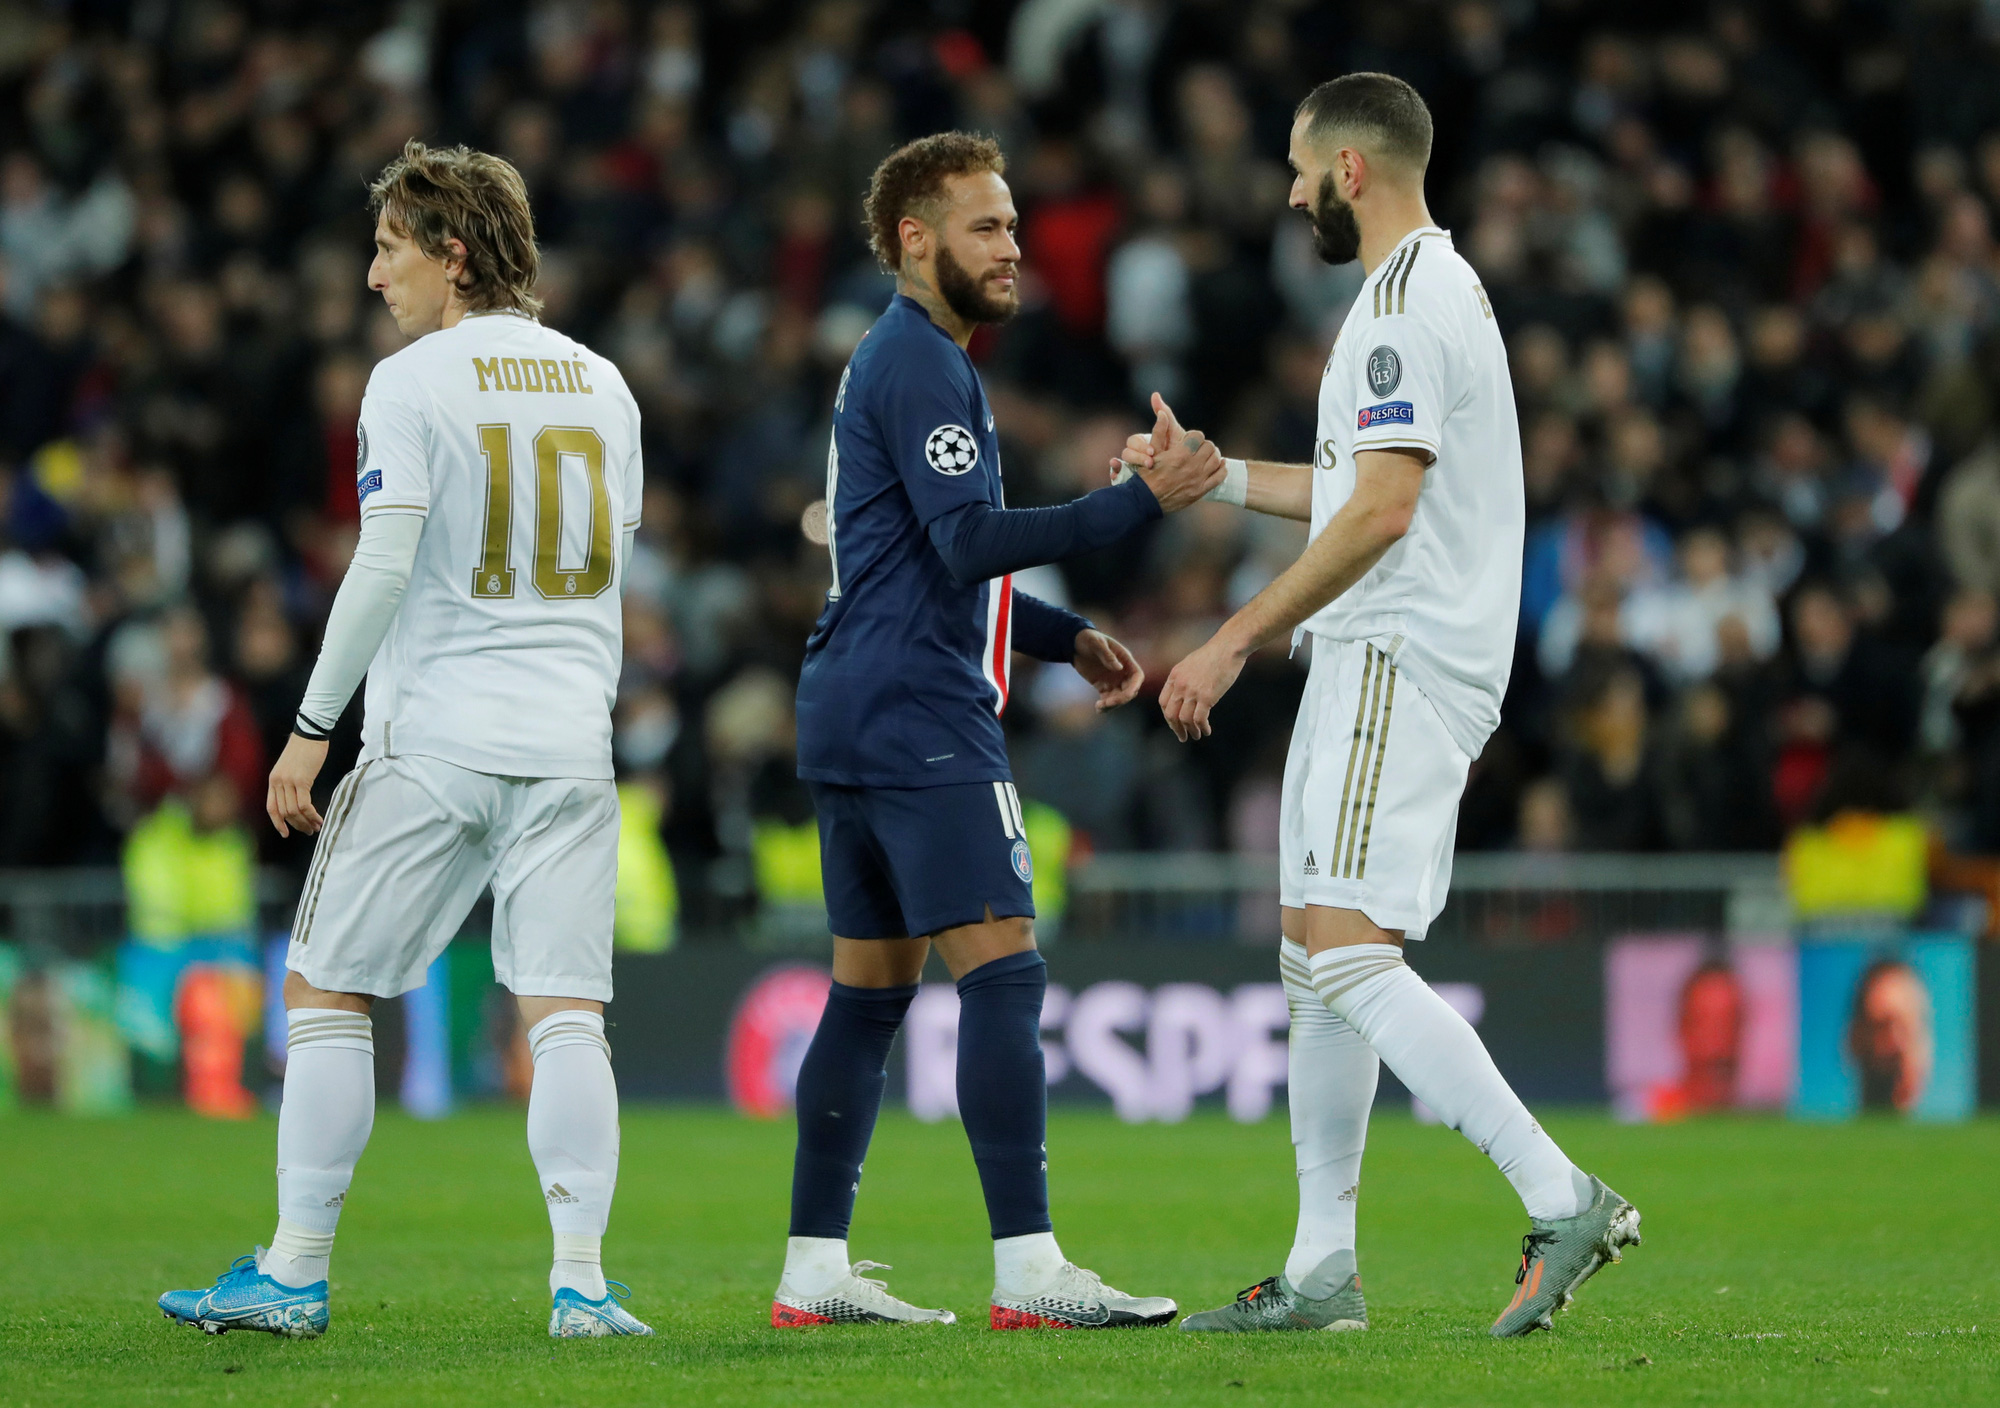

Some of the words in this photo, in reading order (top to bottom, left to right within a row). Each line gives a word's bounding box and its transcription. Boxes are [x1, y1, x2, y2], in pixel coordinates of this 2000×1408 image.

[472, 352, 594, 395] MODRIĆ
[1376, 370, 1390, 385] 13
[1371, 406, 1413, 421] RESPECT
[470, 423, 616, 600] 10
